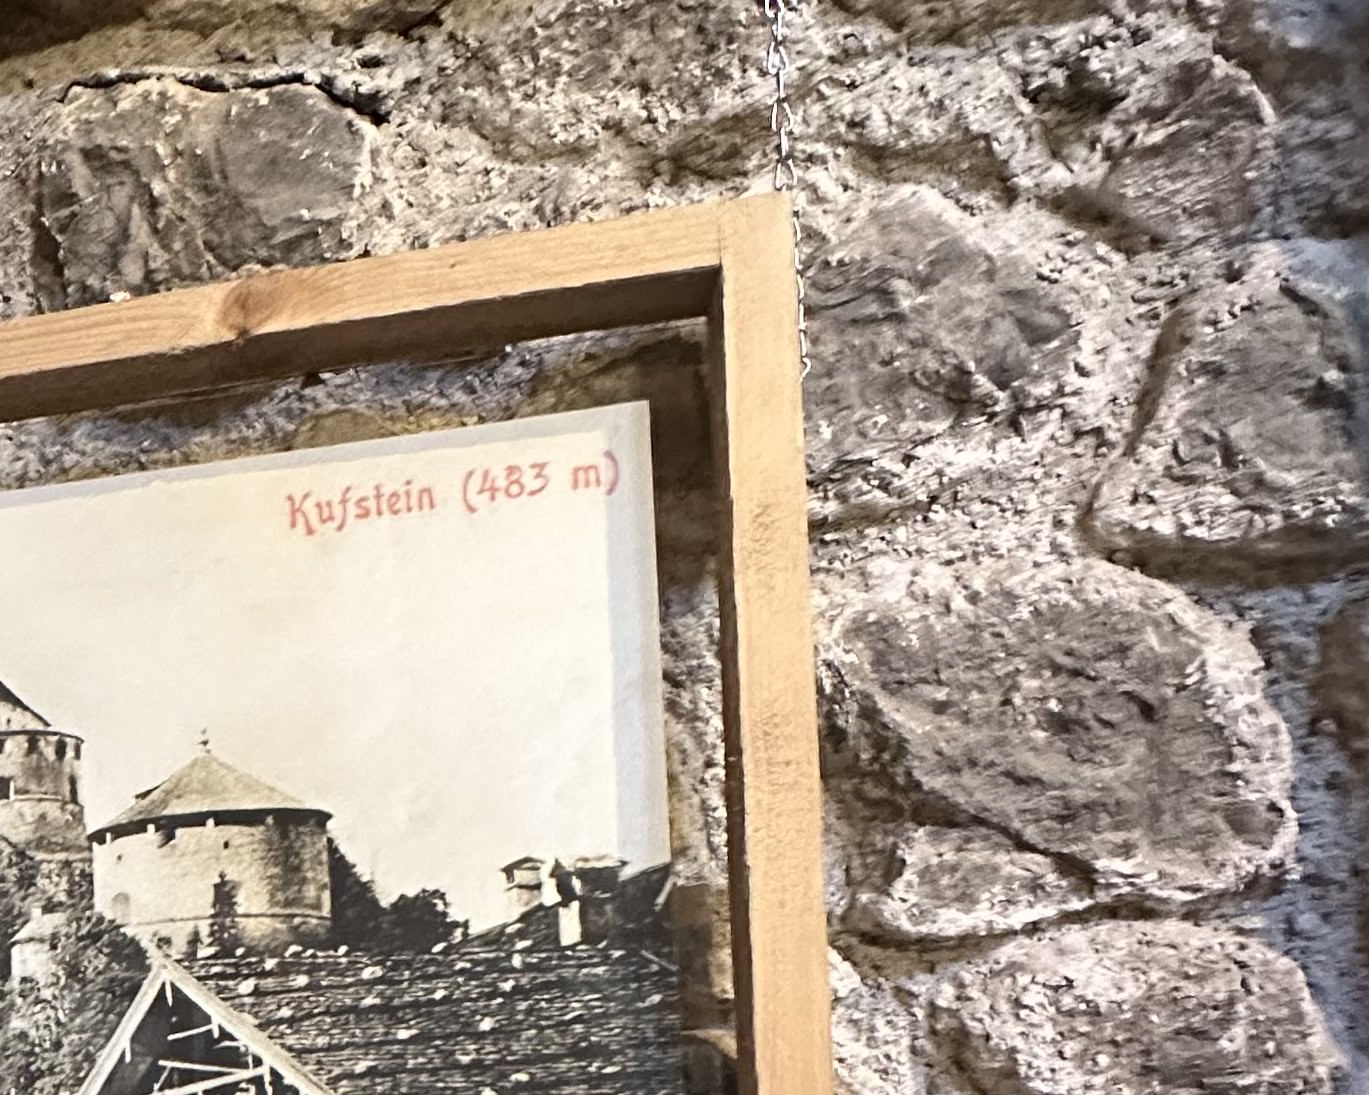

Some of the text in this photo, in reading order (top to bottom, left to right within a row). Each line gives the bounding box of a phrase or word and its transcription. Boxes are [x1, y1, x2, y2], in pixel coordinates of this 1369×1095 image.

[285, 450, 619, 537] Kufstein (483 m)
